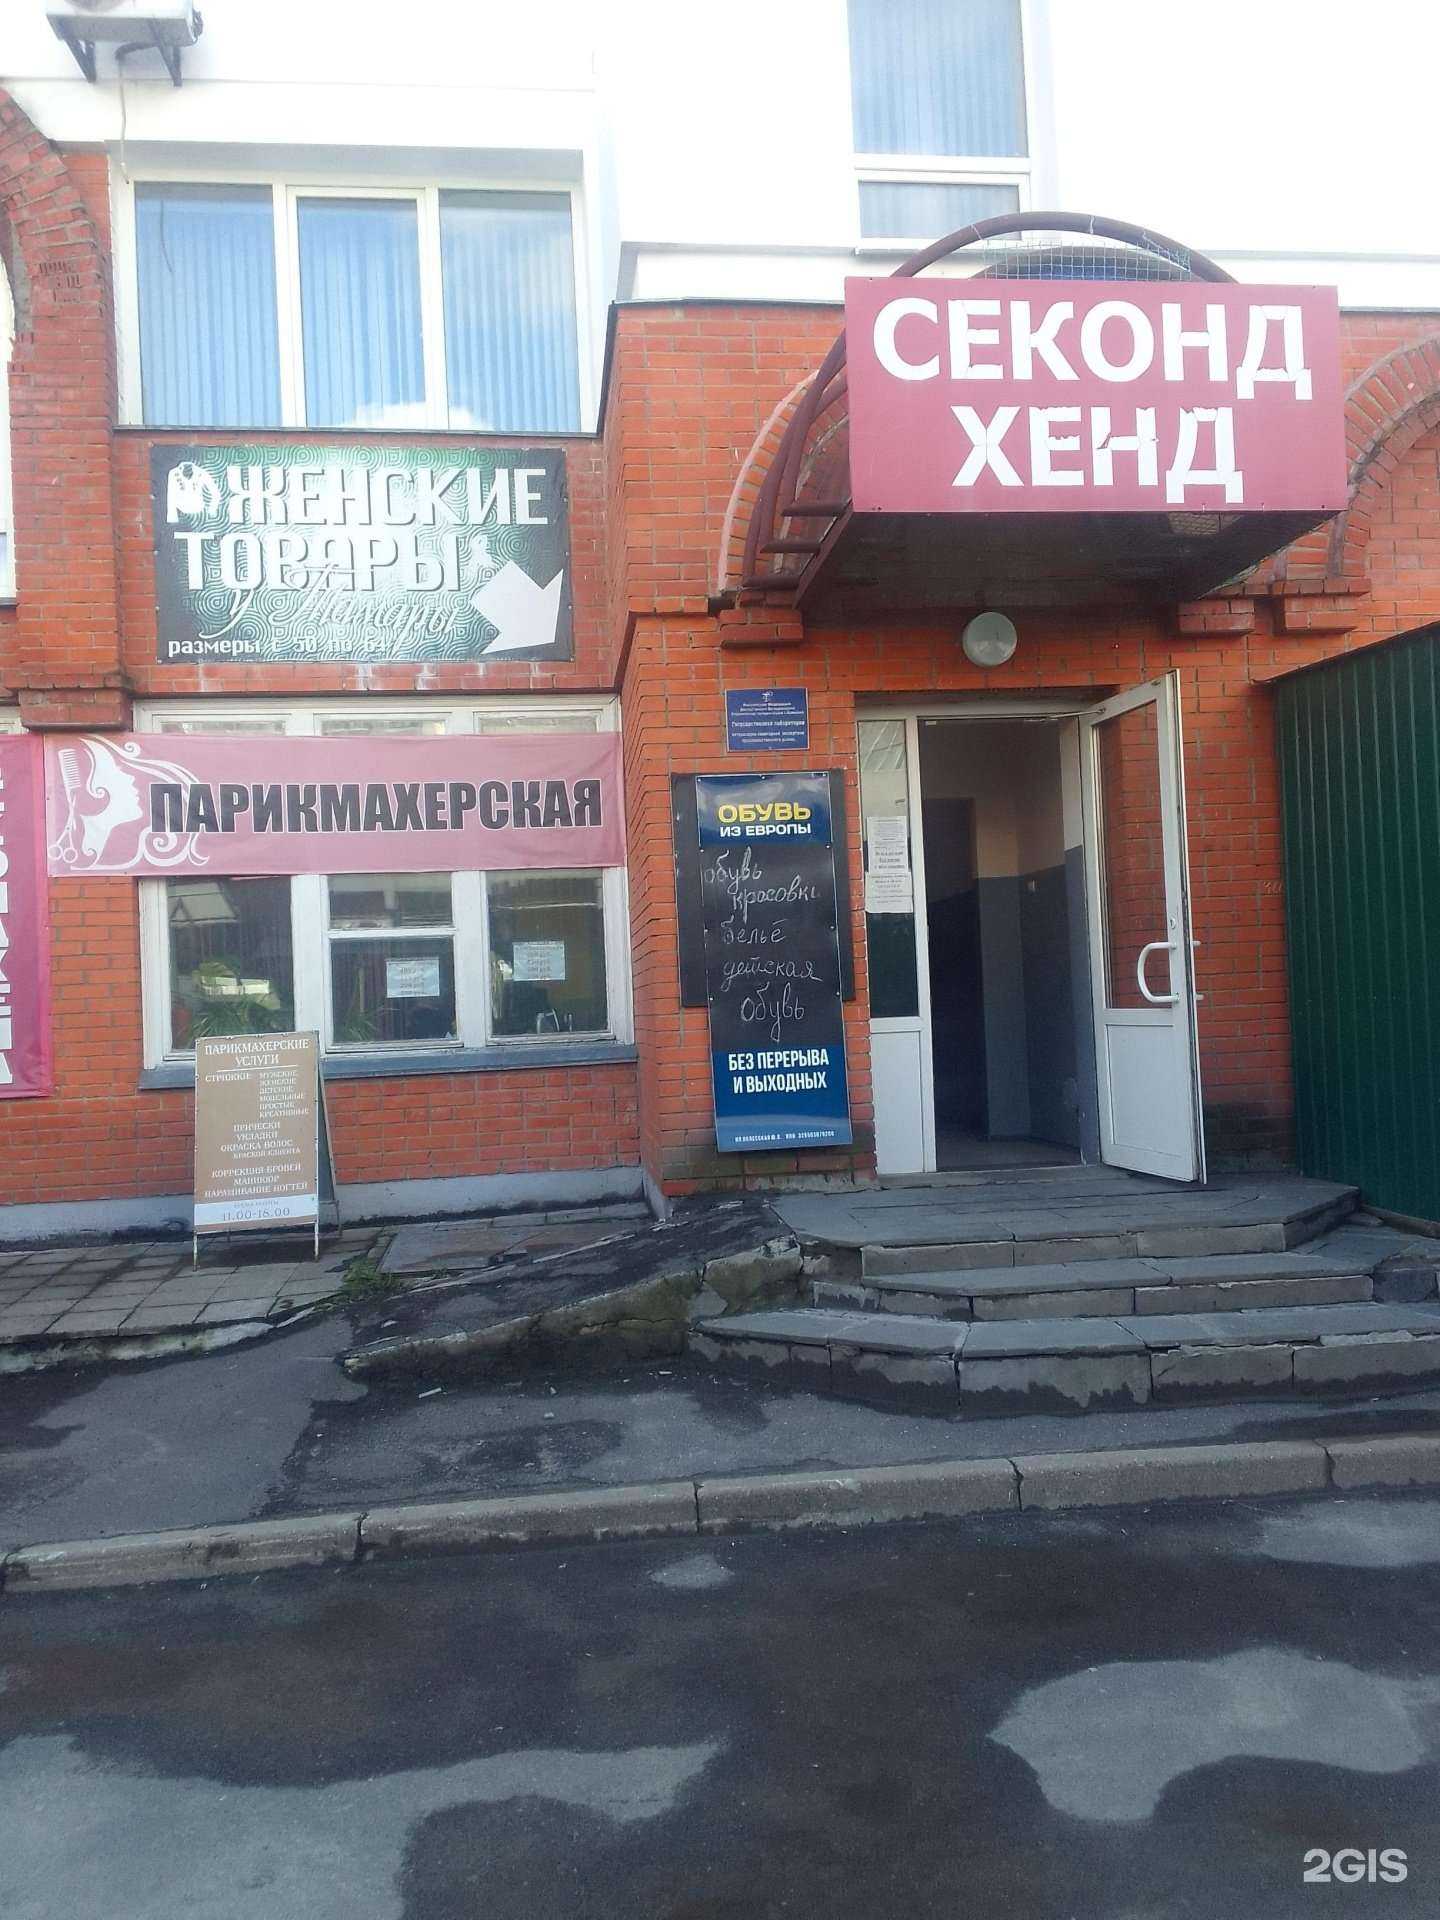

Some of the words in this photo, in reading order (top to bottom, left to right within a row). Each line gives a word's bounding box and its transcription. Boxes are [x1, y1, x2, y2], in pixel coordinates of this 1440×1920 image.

[873, 297, 1313, 400] СЕКОНД
[950, 405, 1244, 504] ХЕНД
[226, 465, 549, 526] ЖЕНСКИЕ
[173, 526, 462, 592] ТОВАРЫ
[168, 639, 260, 657] размеры
[294, 637, 317, 653] 50
[328, 639, 352, 652] по
[149, 779, 603, 833] ПАРИКМАХЕРСКАЯ
[718, 802, 811, 823] ОБУВЬ
[719, 826, 741, 837] ИЗ
[745, 823, 811, 836] ЕВРОПЫ
[704, 846, 763, 895] обувь
[205, 1039, 309, 1056] ПАРИКМАХЕРСКИЕ
[235, 1053, 280, 1067] УСЛУГИ
[728, 1052, 754, 1071] БЕЗ
[757, 1048, 829, 1070] ПЕРЕРЫВА
[733, 1076, 743, 1094] И
[746, 1071, 827, 1093] ВЫХОДНЫХ
